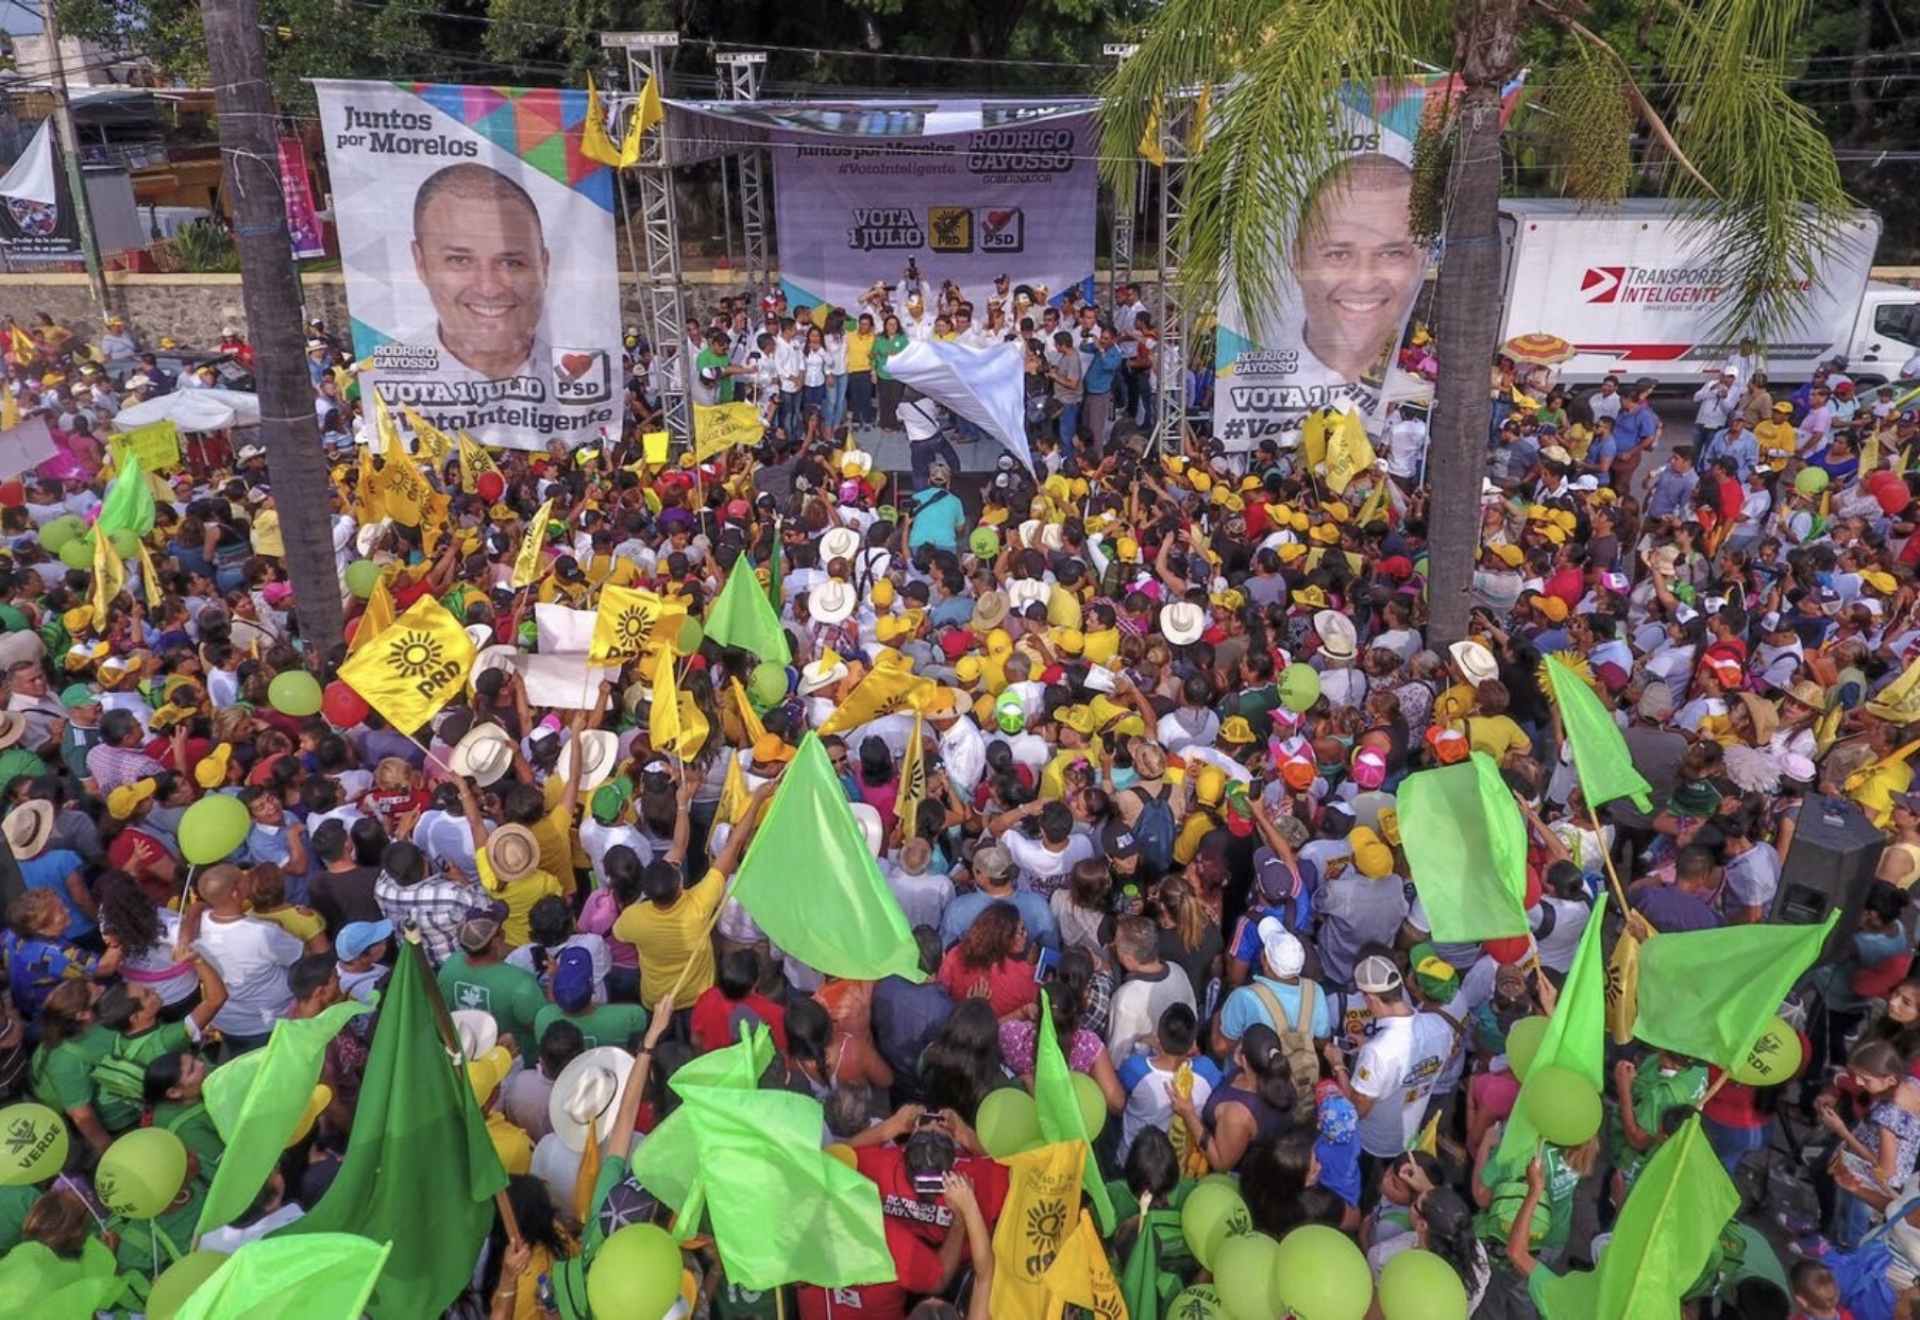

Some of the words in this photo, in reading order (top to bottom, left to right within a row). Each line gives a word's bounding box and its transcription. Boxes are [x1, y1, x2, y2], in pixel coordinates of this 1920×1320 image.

[344, 106, 432, 131] Juntos
[337, 134, 366, 148] por
[369, 132, 477, 157] Morelos
[885, 142, 955, 156] Morelos
[969, 130, 1071, 150] RODRIGO
[838, 162, 956, 177] #VotoInteligente
[967, 150, 1070, 170] GAYOSSO
[853, 209, 915, 227] VOTA
[848, 228, 858, 246] 1
[862, 228, 923, 248] JULIO
[983, 234, 1014, 246] PSD
[1621, 286, 1720, 303] INTELIGENTE
[373, 345, 436, 357] RODRIGO
[1236, 350, 1298, 363] RODRIGO
[373, 357, 438, 370] GAYOSSO
[1233, 361, 1298, 375] GAYOSSO
[376, 381, 454, 403] VOTA
[455, 382, 471, 402] 1
[473, 377, 544, 405] JULIO
[558, 381, 600, 396] PSD
[1232, 386, 1304, 409] VOTA
[1309, 386, 1322, 408] 1
[389, 405, 612, 435] VotoInteligente
[416, 660, 461, 700] PRD
[1747, 1051, 1772, 1076] RDE
[18, 1123, 61, 1169] VERDE
